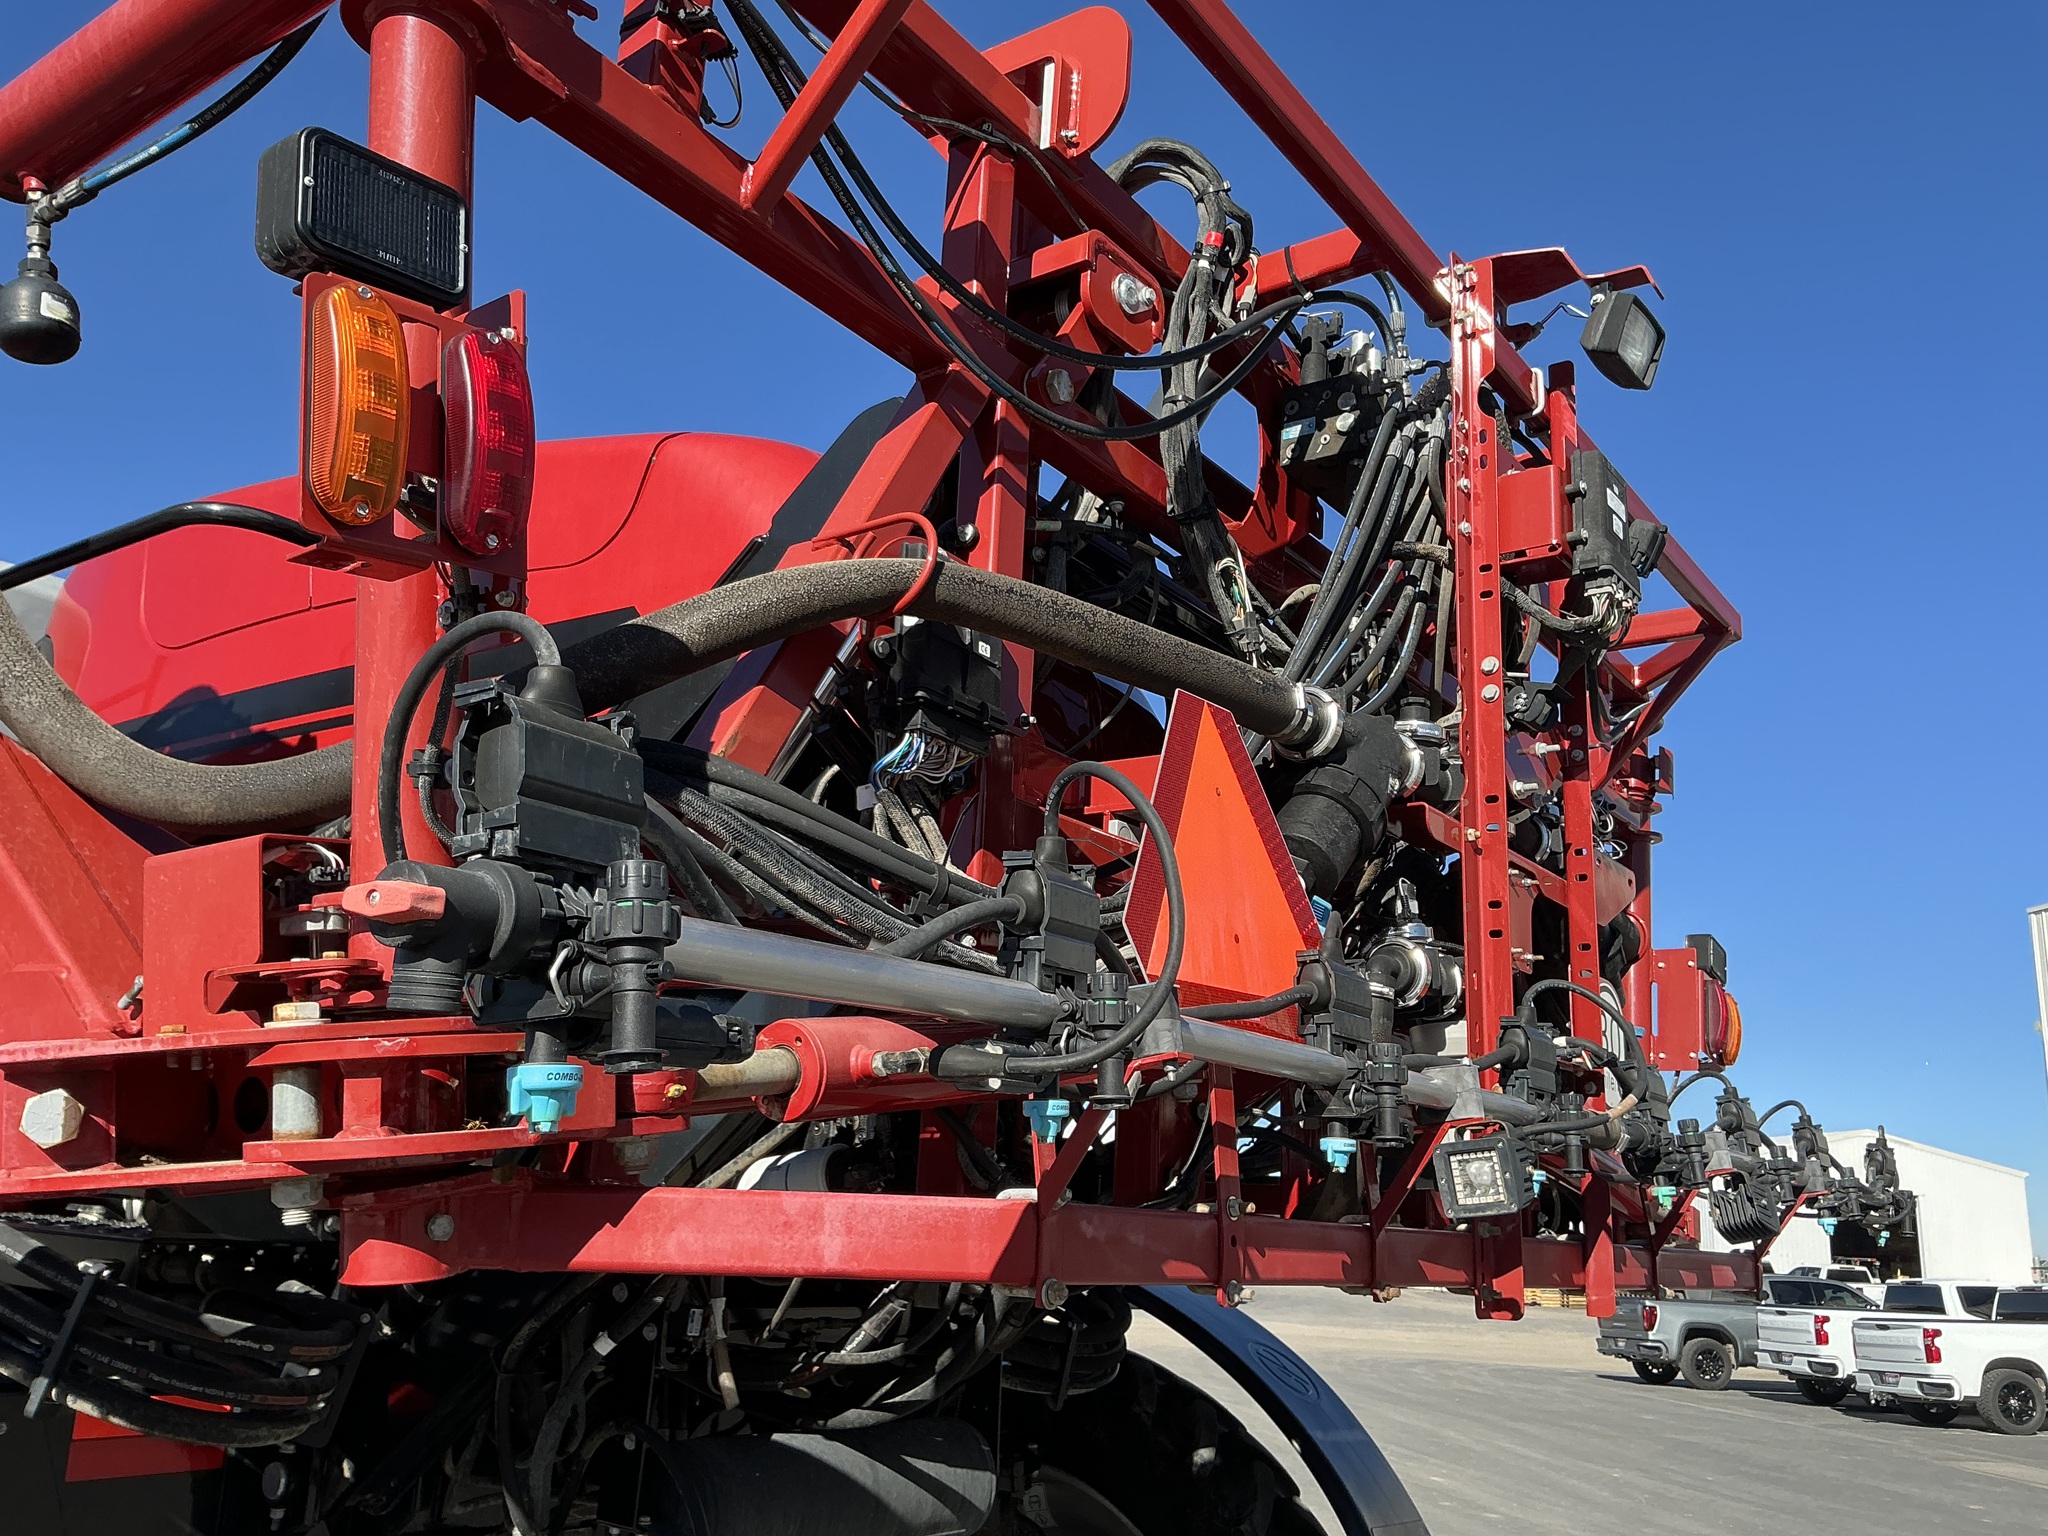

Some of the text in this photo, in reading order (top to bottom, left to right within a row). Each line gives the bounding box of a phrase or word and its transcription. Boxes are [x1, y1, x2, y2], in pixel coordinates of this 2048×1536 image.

[837, 190, 849, 204] MPa
[844, 201, 856, 216] 22.5
[146, 1371, 169, 1384] Flame
